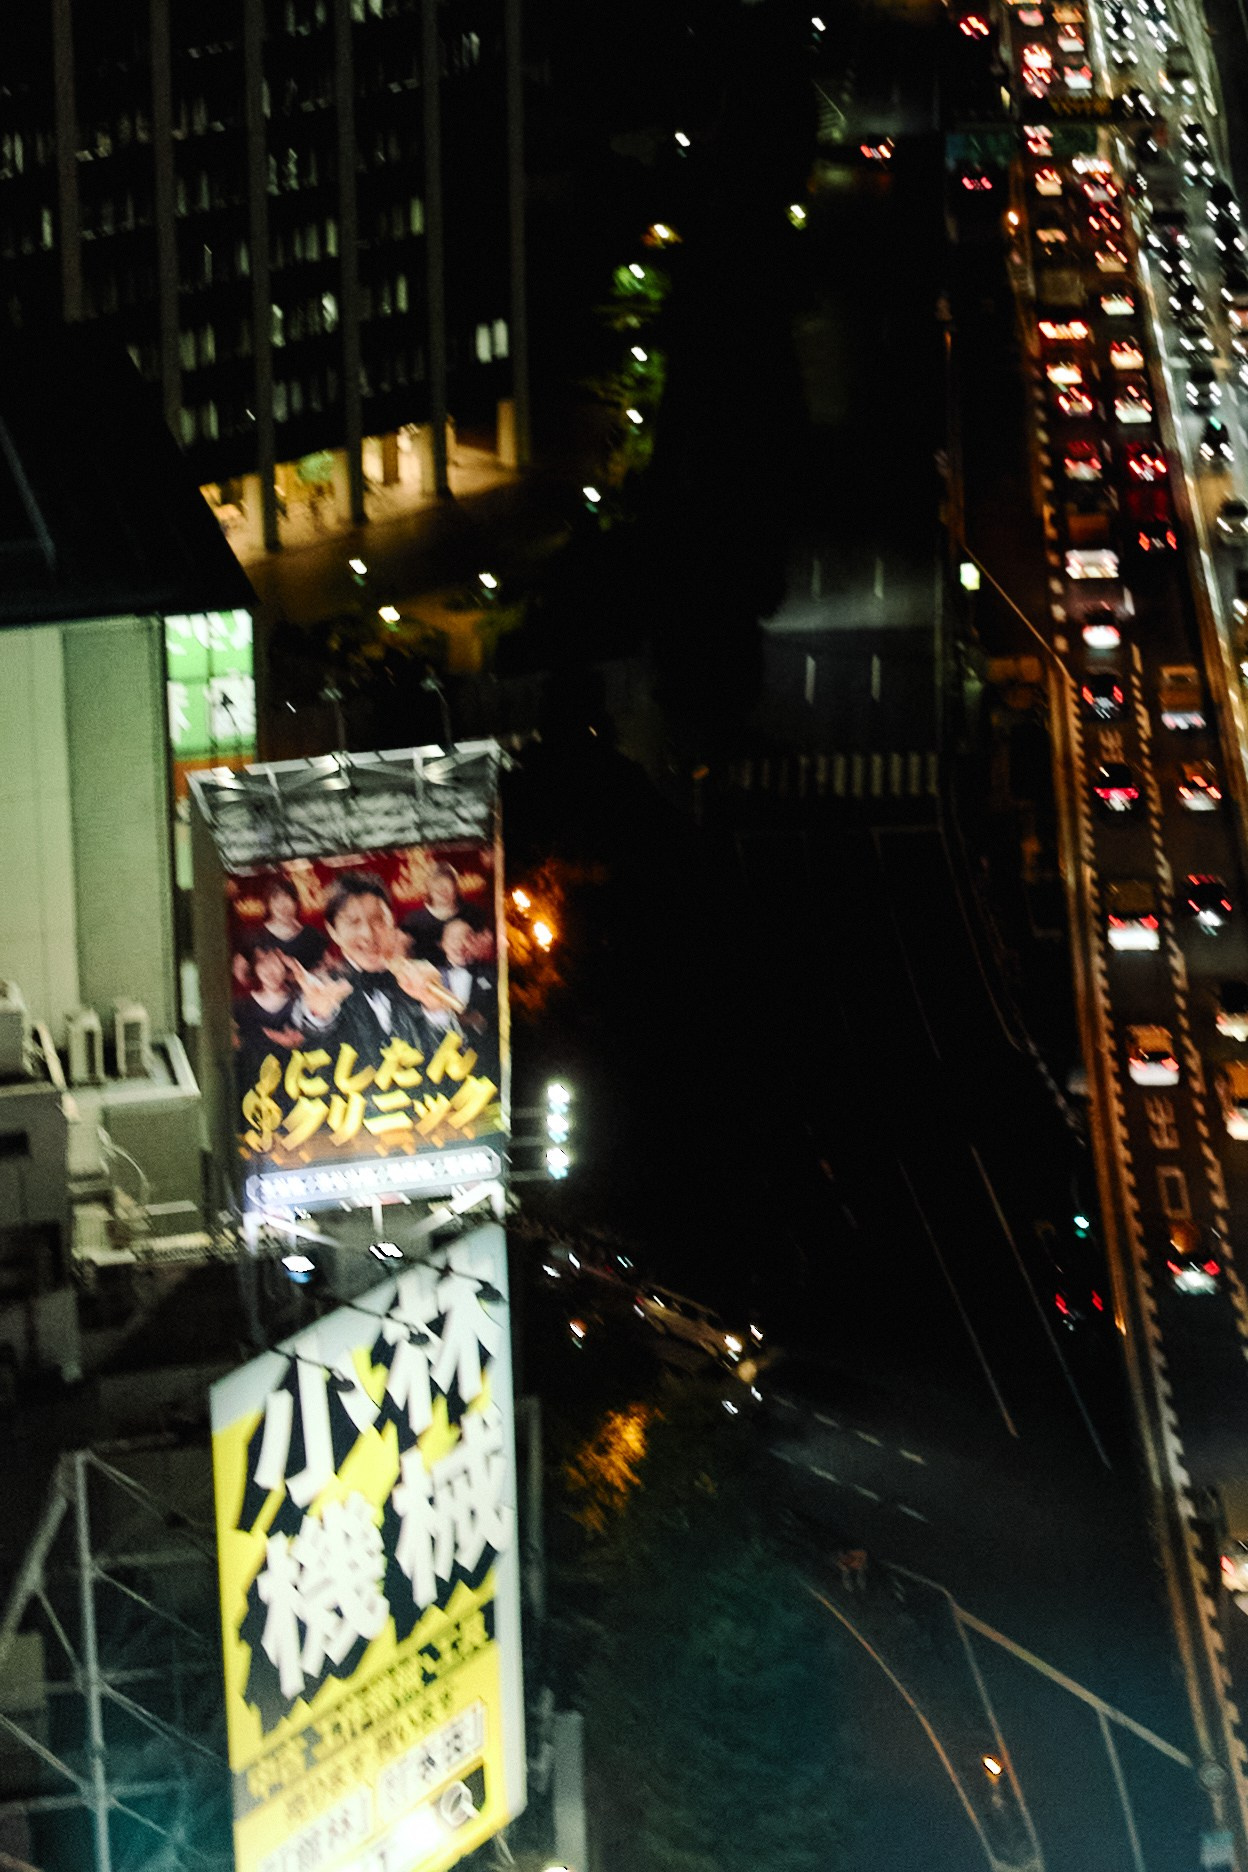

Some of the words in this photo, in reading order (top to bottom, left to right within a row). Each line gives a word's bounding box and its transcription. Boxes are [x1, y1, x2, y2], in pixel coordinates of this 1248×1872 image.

[281, 1075, 498, 1151] クリニック
[285, 1030, 478, 1100] にしたん
[254, 1243, 503, 1509] 小林
[256, 1410, 508, 1699] 機械
